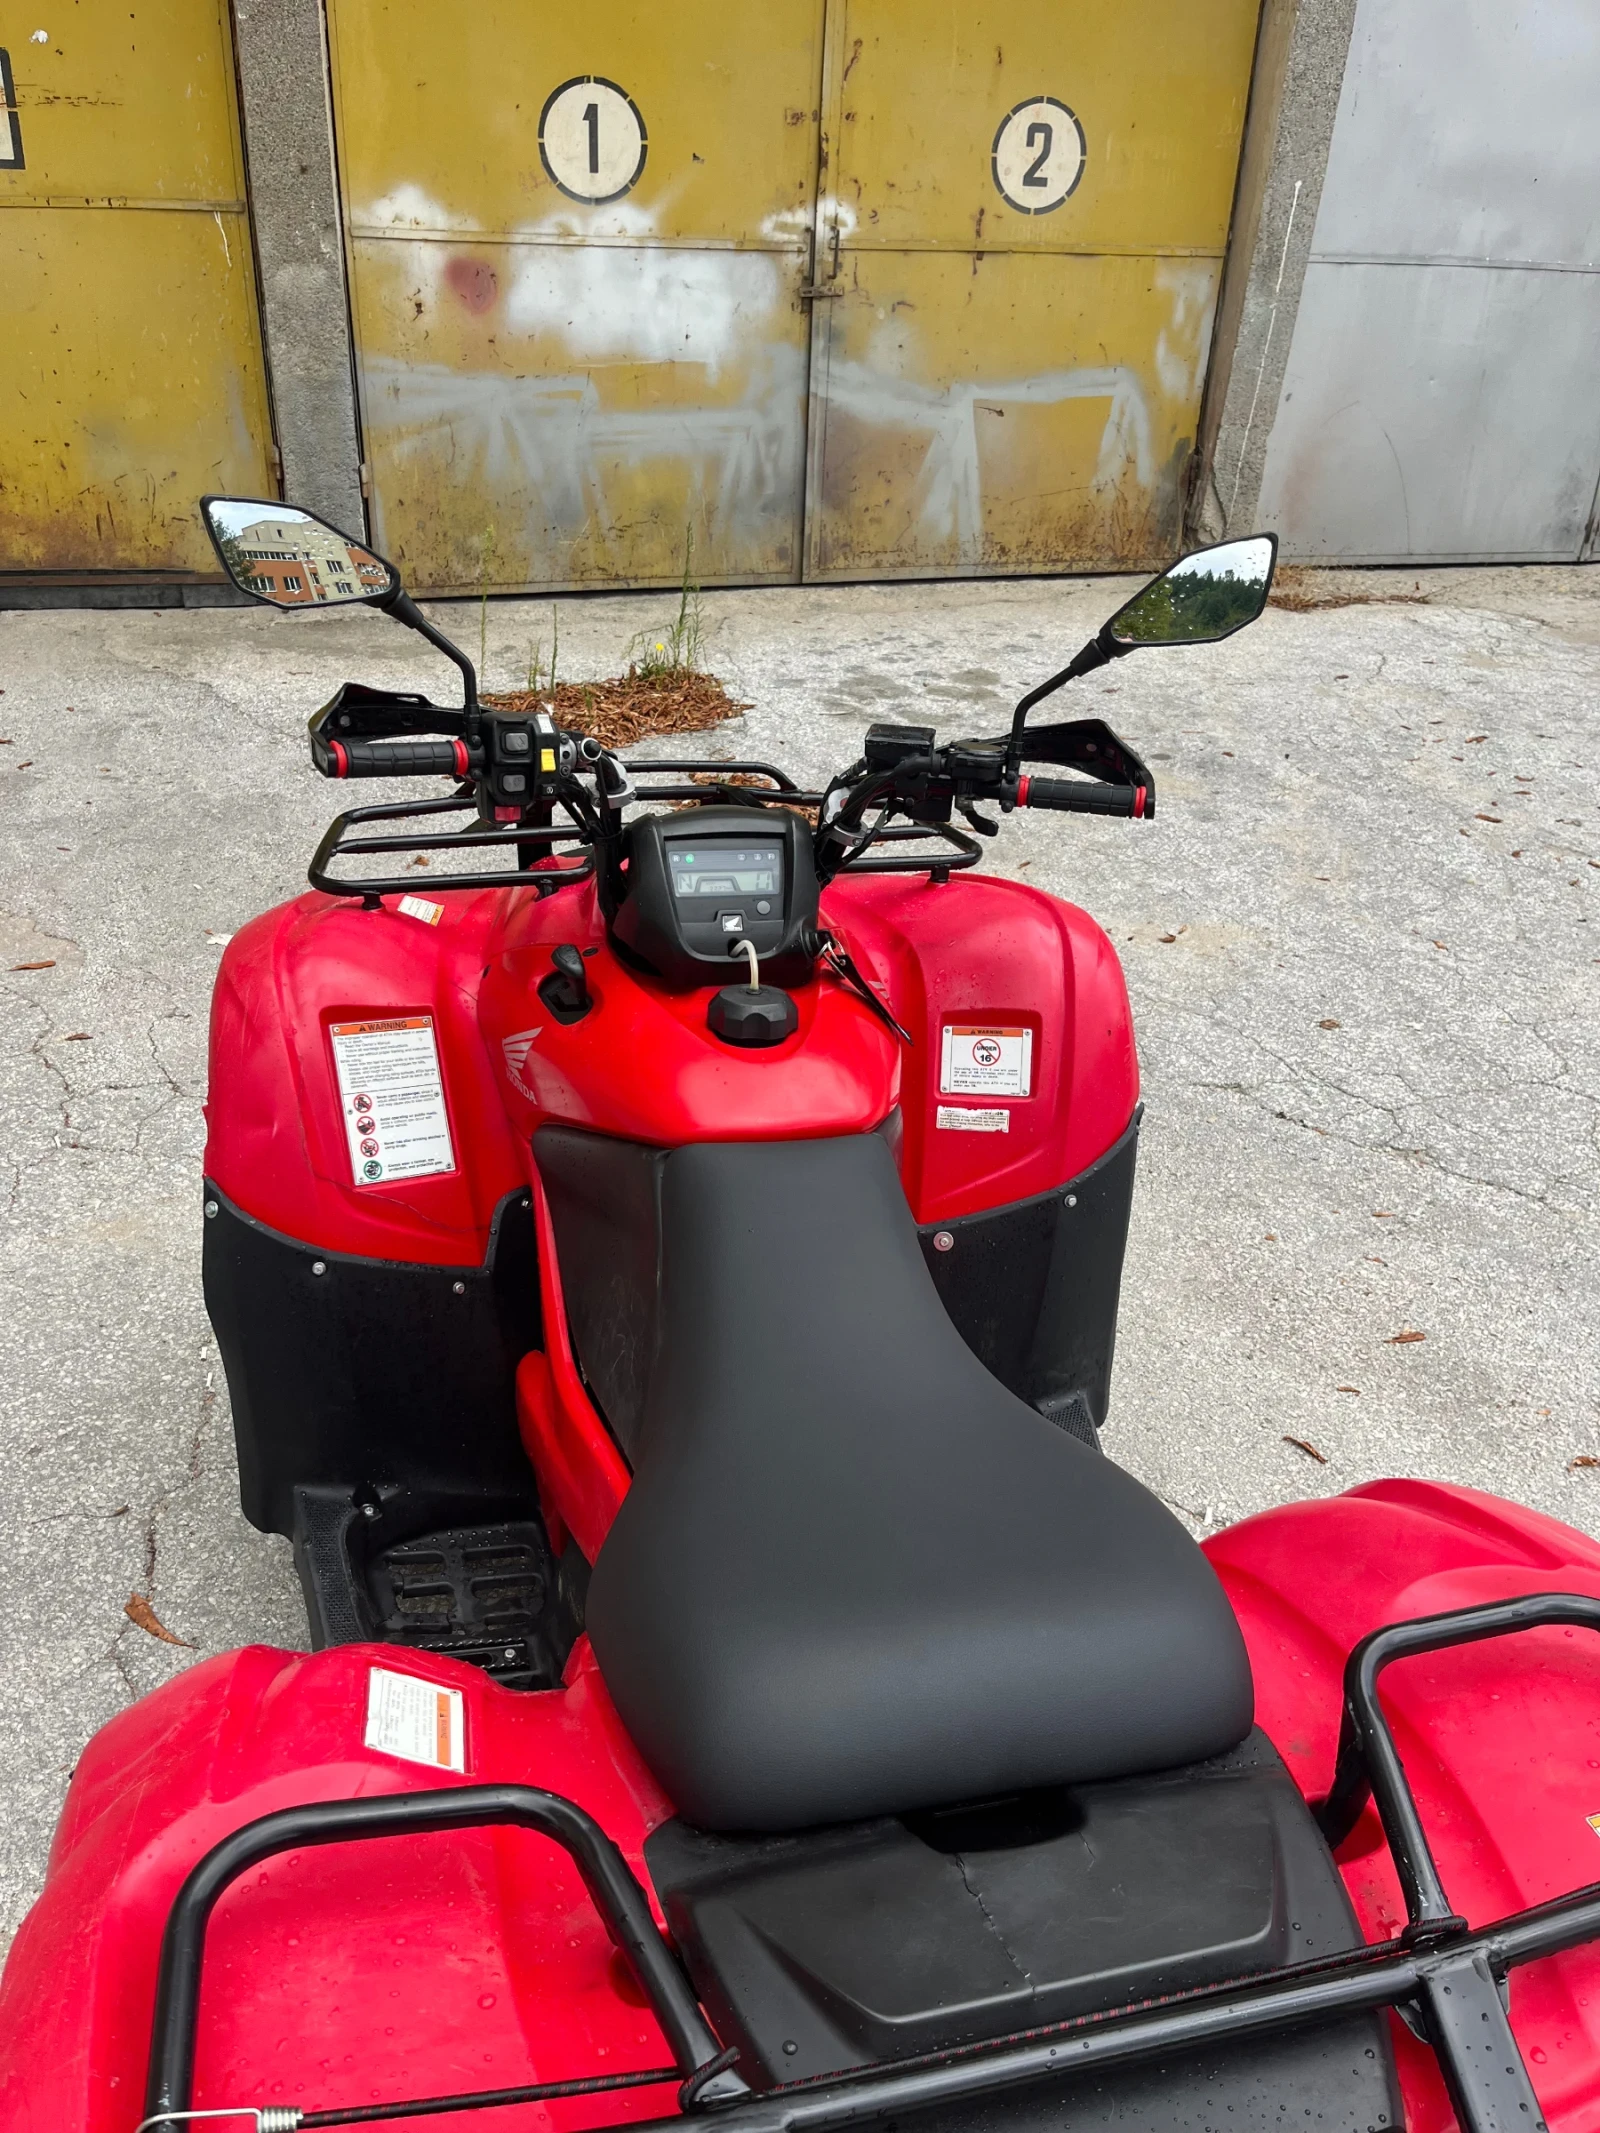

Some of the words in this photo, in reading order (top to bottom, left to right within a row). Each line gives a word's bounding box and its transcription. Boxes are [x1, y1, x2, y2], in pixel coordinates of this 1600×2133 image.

[582, 103, 599, 174] 1
[1022, 122, 1053, 188] 2
[367, 1020, 407, 1032] WARNING
[979, 1054, 992, 1063] 16
[505, 1066, 538, 1106] HONDA
